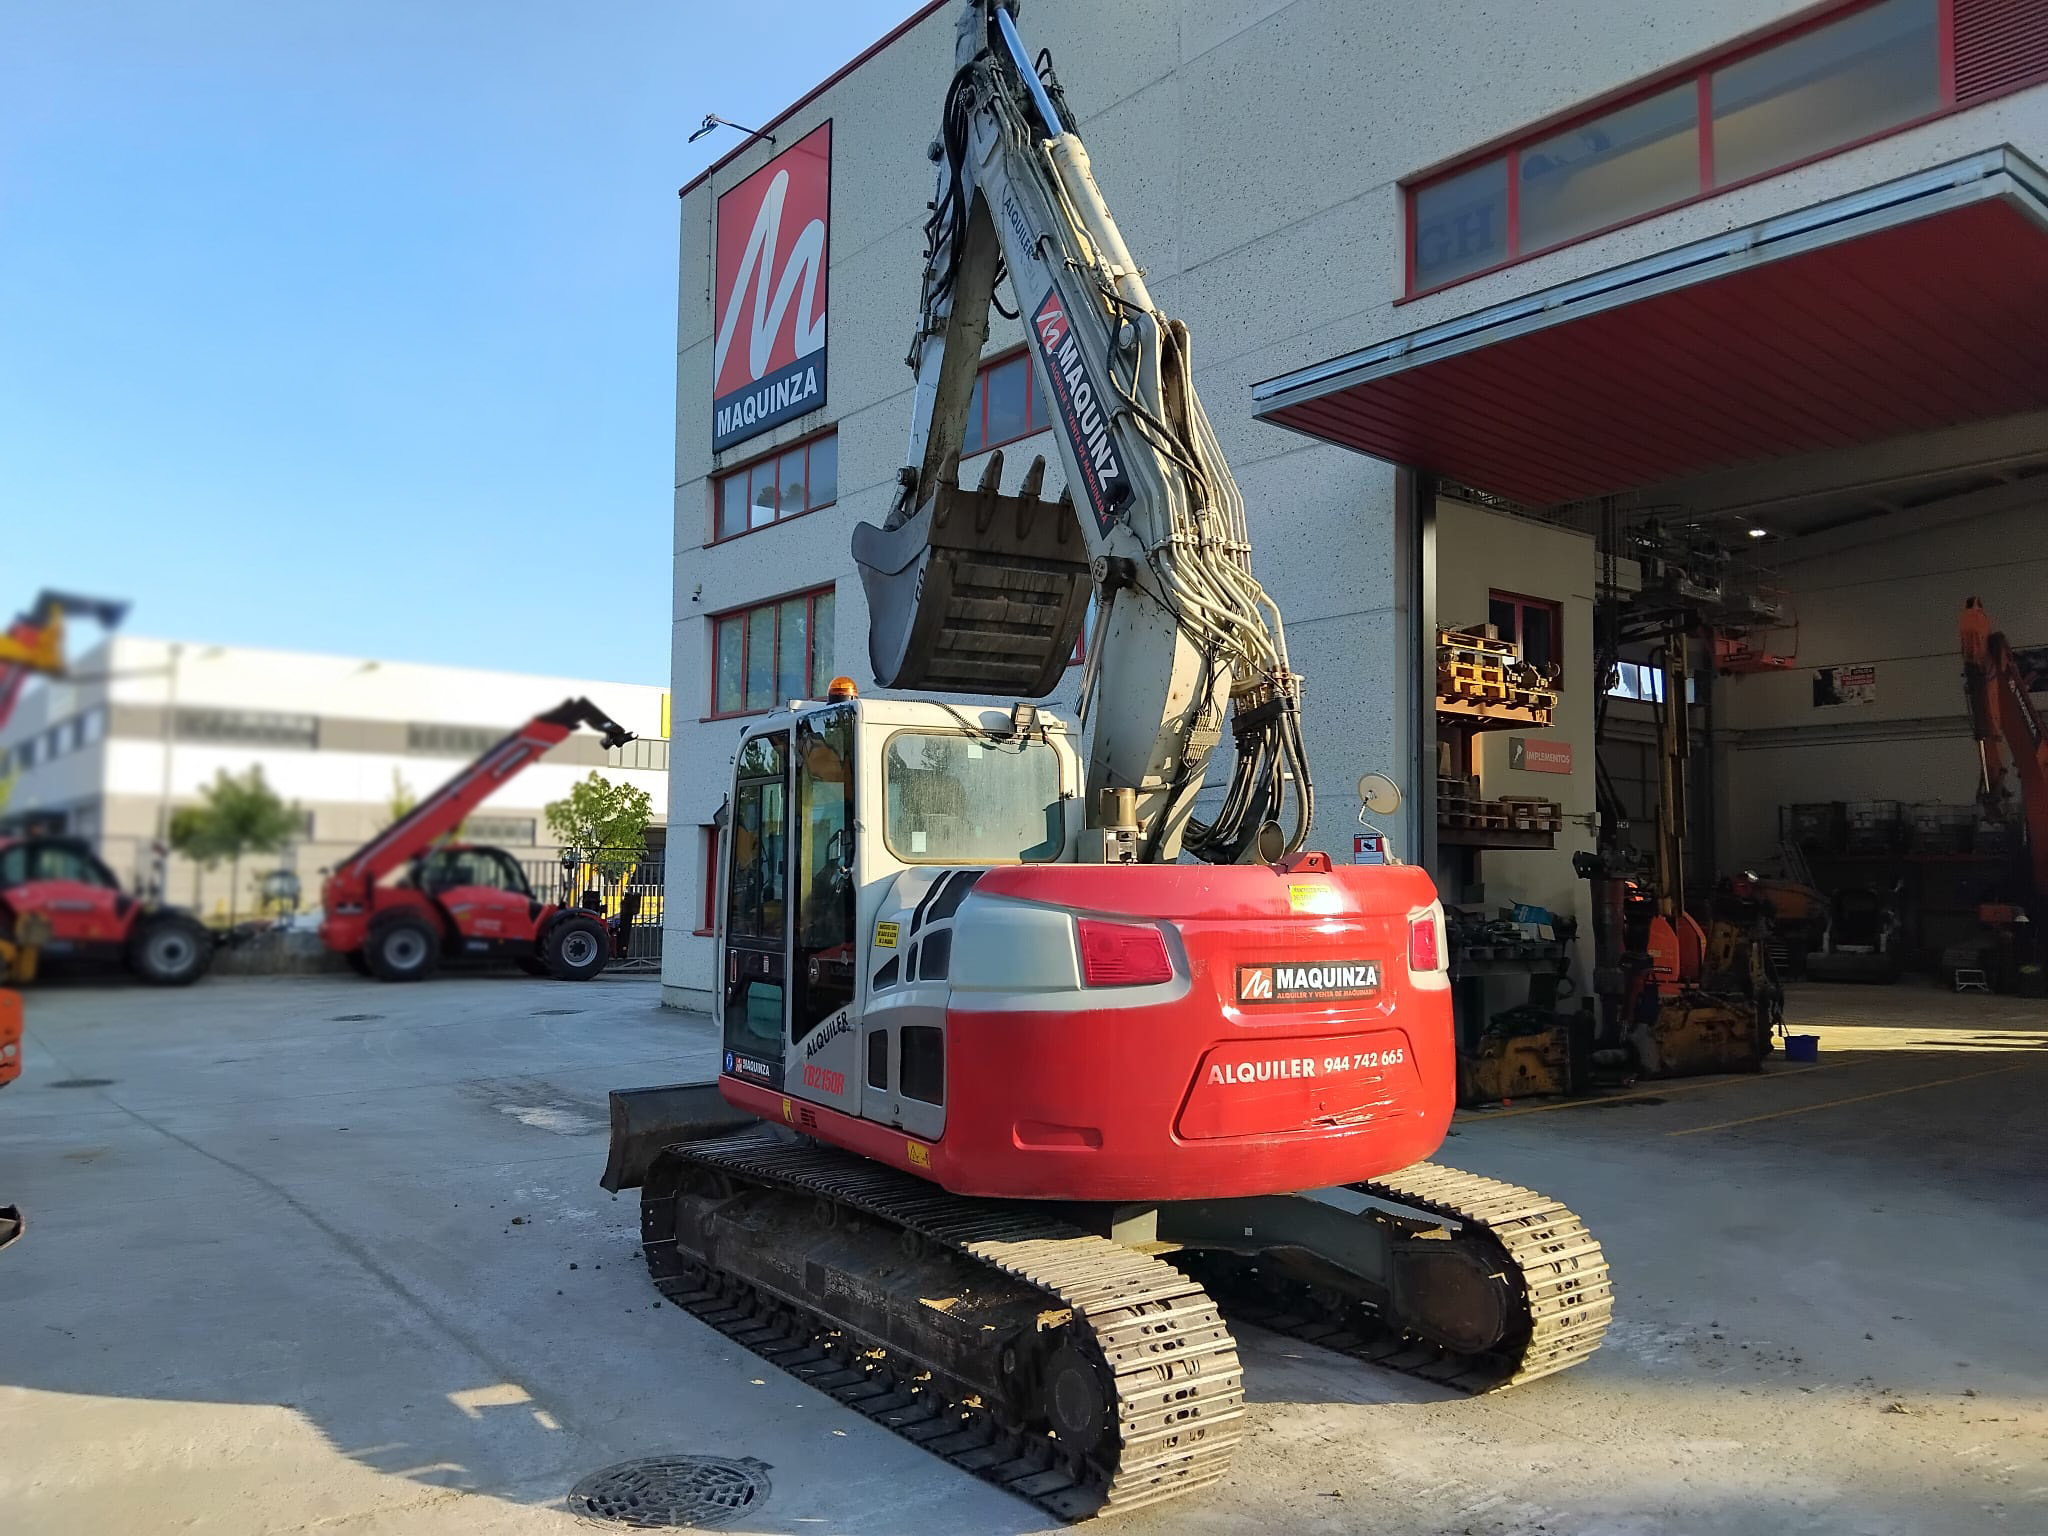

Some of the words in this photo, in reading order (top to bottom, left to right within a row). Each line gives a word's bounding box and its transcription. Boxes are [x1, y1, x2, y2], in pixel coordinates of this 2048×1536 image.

[1004, 197, 1035, 260] ALQUILER
[717, 366, 818, 438] MAQUINZA
[1059, 334, 1120, 493] MAQUINZ
[1050, 361, 1068, 405] ALQUILER
[1068, 412, 1081, 445] VENTA
[1078, 444, 1087, 458] DE
[1083, 459, 1108, 525] MAQUINARA
[1526, 751, 1570, 764] IMPLEMENTOS
[1277, 966, 1378, 990] MAQUINZA
[1277, 991, 1307, 999] ALQUILER
[806, 1011, 849, 1060] ALQUILER
[1208, 1058, 1316, 1085] ALQUILER
[1323, 1055, 1350, 1073] 944
[1353, 1052, 1378, 1070] 742
[1381, 1049, 1404, 1066] 665
